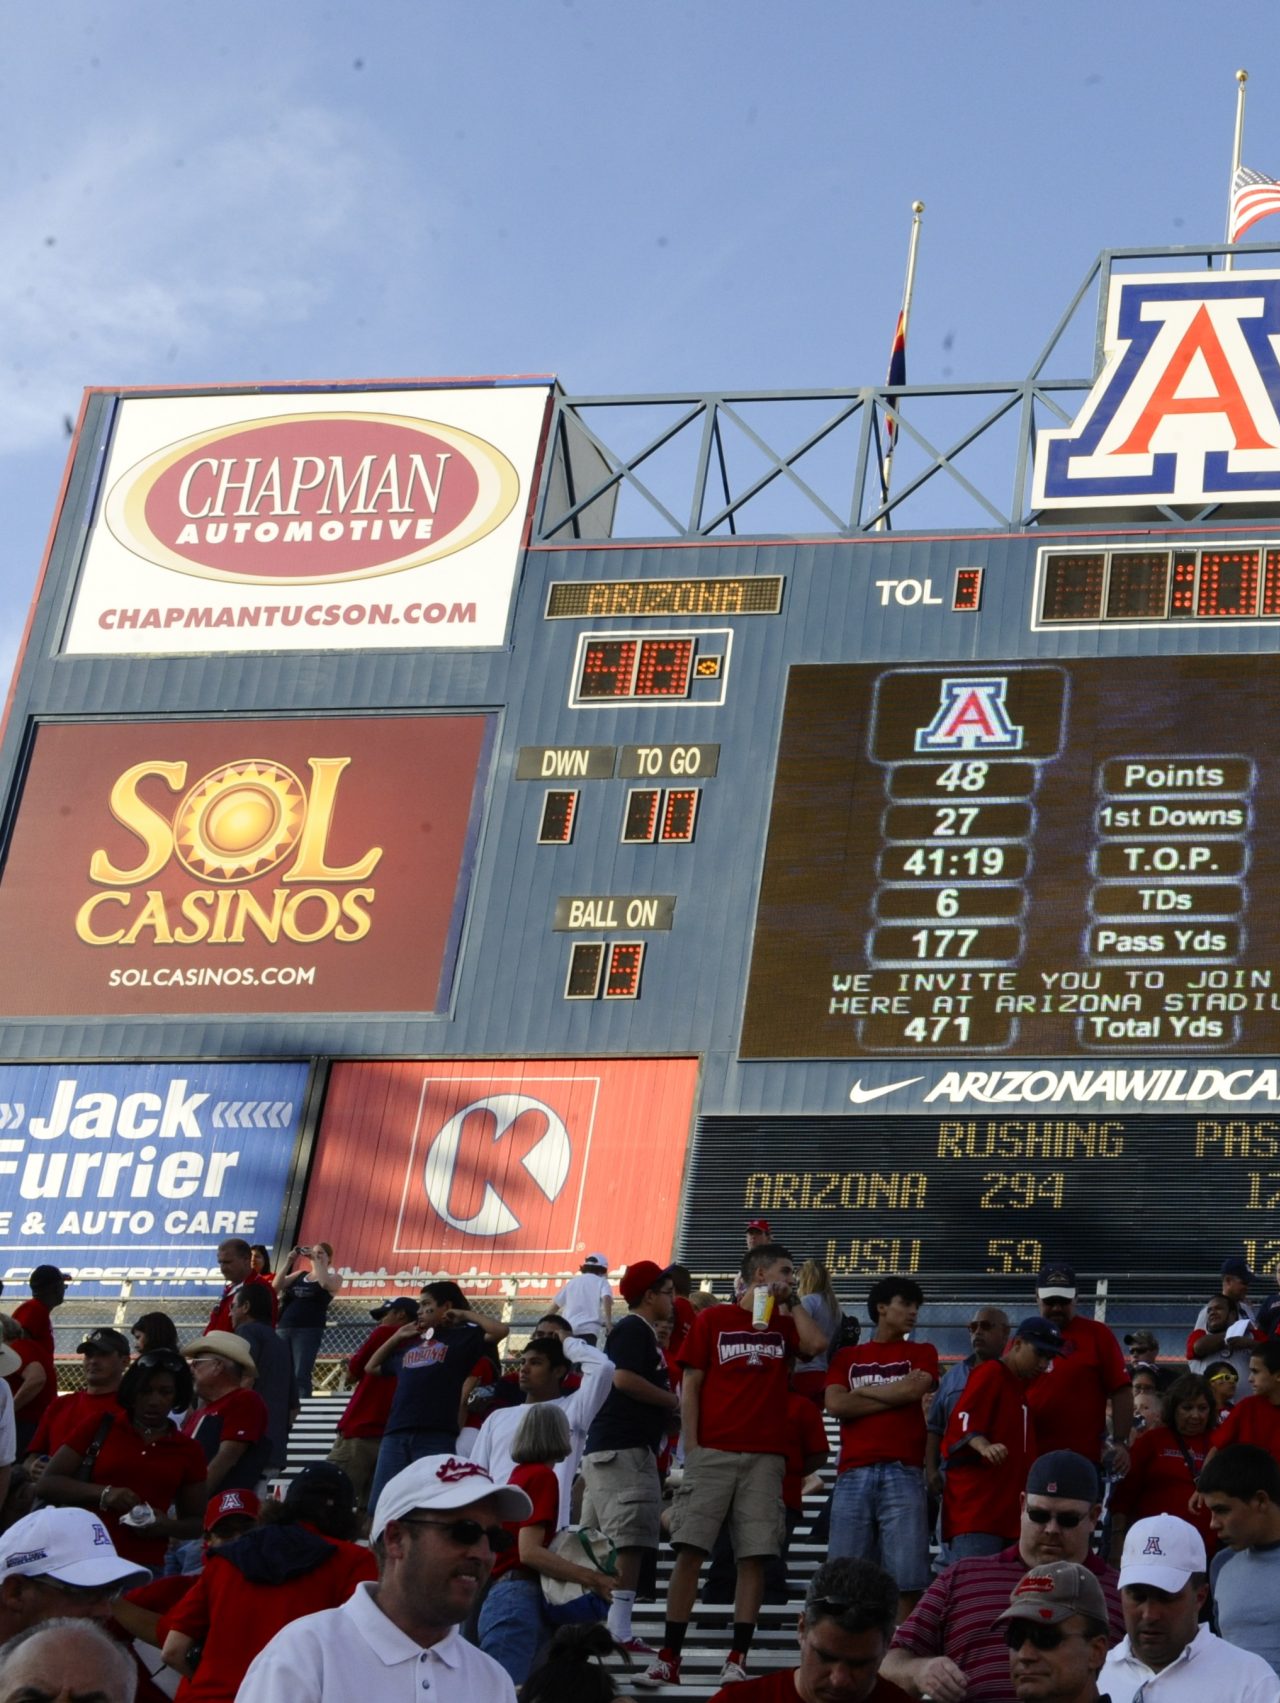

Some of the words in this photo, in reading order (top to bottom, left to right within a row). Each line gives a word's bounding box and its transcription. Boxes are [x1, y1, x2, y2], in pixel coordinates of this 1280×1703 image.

[178, 453, 453, 520] CHAPMAN
[176, 517, 433, 545] AUTOMOTIVE
[588, 582, 745, 616] ARIZONA
[876, 579, 943, 606] TOL
[955, 570, 980, 610] 3
[98, 602, 478, 630] CHAPMANTUCSON.COM
[584, 641, 693, 697] 48
[541, 750, 590, 777] DWN
[636, 748, 665, 775] TO
[669, 747, 701, 775] GO
[935, 761, 990, 792] 48
[1125, 765, 1225, 788] Points
[88, 757, 384, 887] SOL
[933, 808, 980, 837] 27
[1100, 807, 1141, 827] 1st
[1149, 807, 1244, 827] Downs
[903, 847, 1005, 877] 41:19
[1124, 847, 1219, 872] T.O.P.
[568, 900, 619, 928] BALL
[626, 900, 659, 927] ON
[936, 889, 960, 918] 6
[1138, 890, 1193, 911] TDs
[75, 888, 376, 946] CASINOS
[911, 929, 979, 959] 177
[1098, 931, 1165, 952] Pass
[1175, 929, 1228, 952] Yds
[108, 966, 316, 988] SOLCASINOS.COM
[608, 946, 641, 995] 9
[832, 974, 874, 992] WE
[899, 973, 1018, 992] INVITE
[1041, 971, 1101, 990] YOU
[1125, 971, 1164, 989] TO
[1188, 970, 1271, 989] JOIN
[828, 996, 911, 1015] HERE
[932, 995, 974, 1014] AT
[995, 993, 1142, 1013] ARIZONA
[904, 1016, 971, 1042] 471
[1090, 1016, 1161, 1038] Total
[1170, 1015, 1224, 1038] Yds
[28, 1079, 211, 1140] Jack
[937, 1121, 1124, 1158] RUSHING
[0, 1138, 240, 1200] Furrier
[743, 1172, 928, 1210] ARIZONA
[980, 1172, 1064, 1210] 294
[20, 1211, 46, 1235] &
[56, 1210, 155, 1235] AUTO
[164, 1210, 259, 1235] CARE
[825, 1239, 922, 1276] WSU
[986, 1239, 1043, 1276] 59
